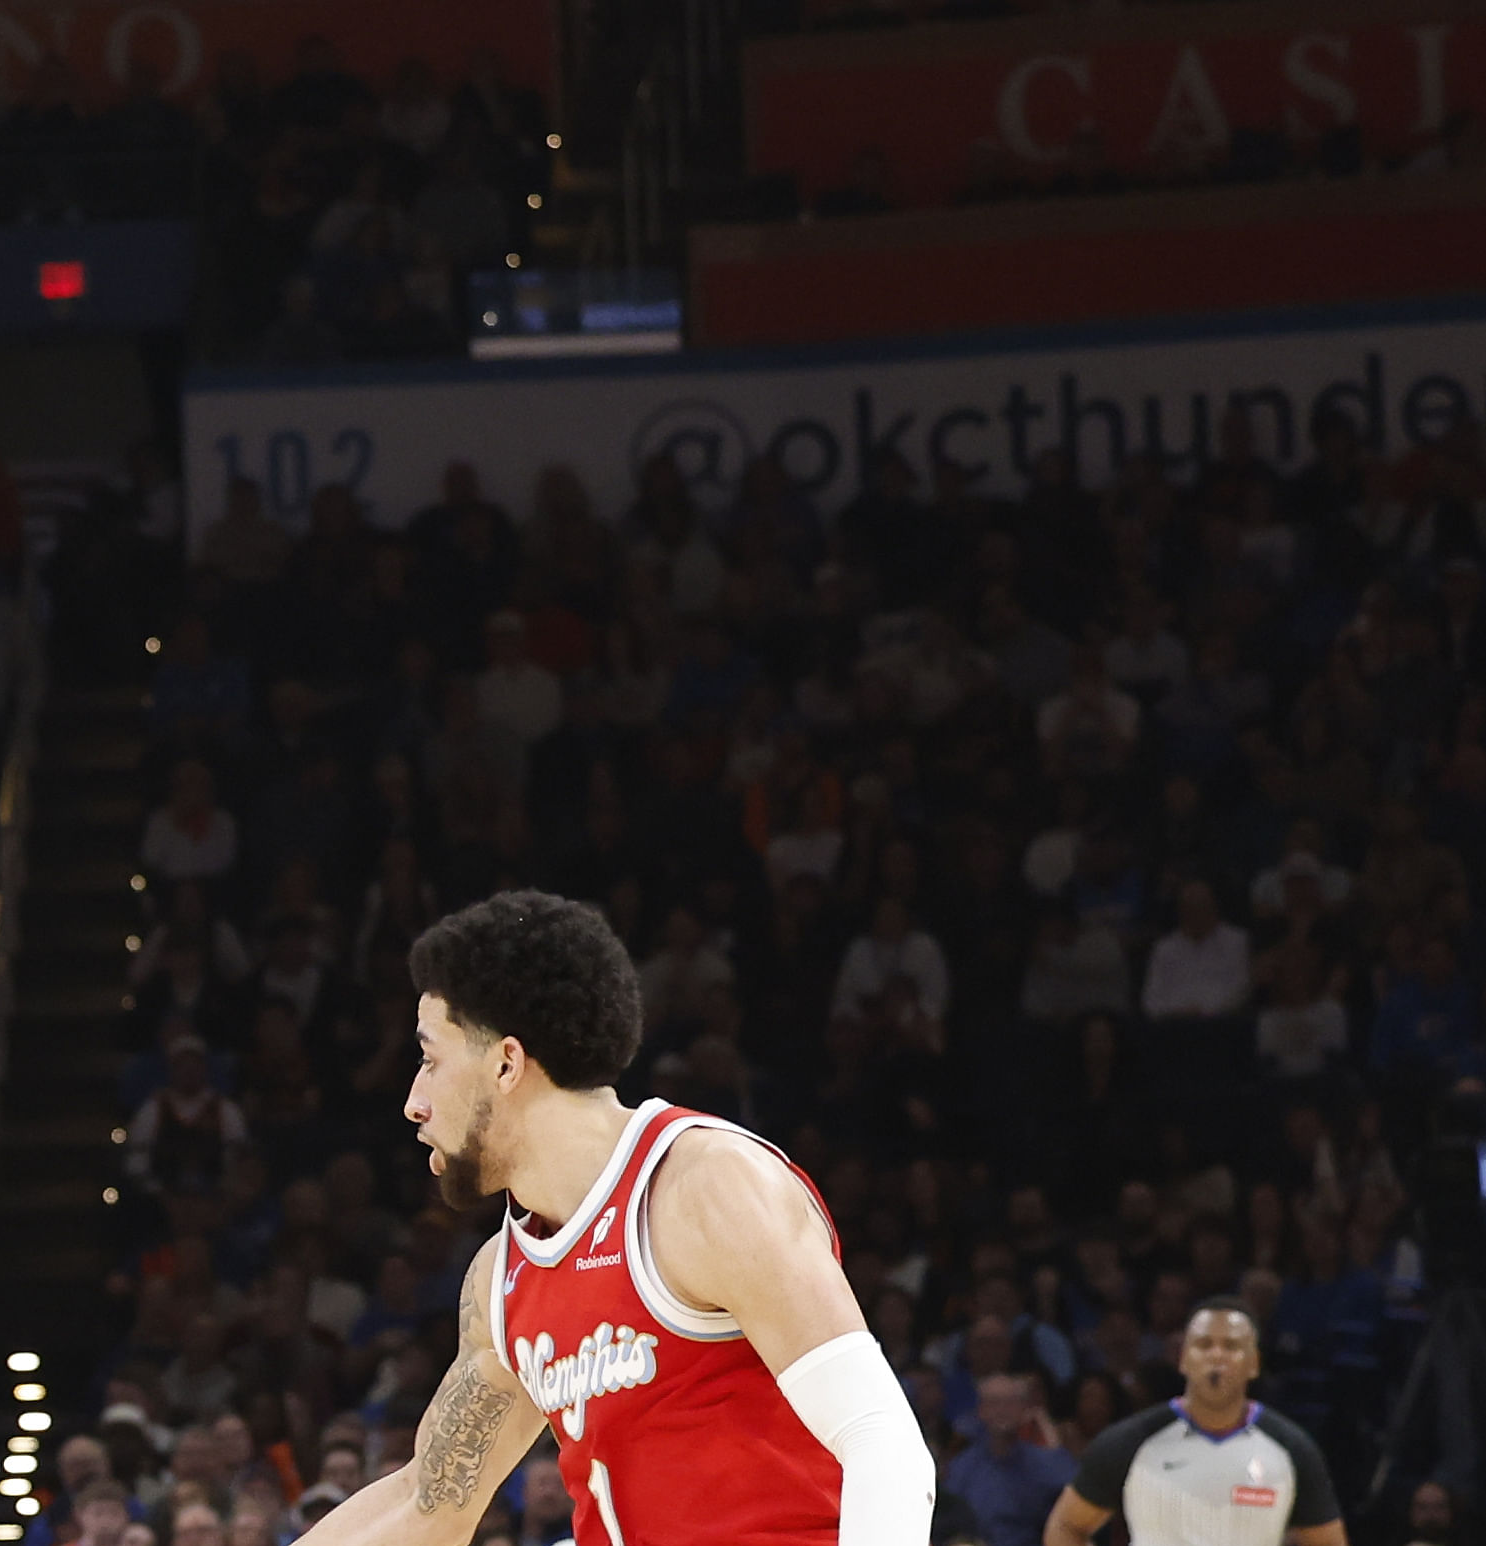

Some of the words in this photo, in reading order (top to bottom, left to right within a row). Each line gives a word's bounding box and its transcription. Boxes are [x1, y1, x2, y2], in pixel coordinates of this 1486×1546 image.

[629, 351, 1486, 494] @okcthunde
[576, 1251, 621, 1271] Robinhood
[515, 1321, 658, 1441] Memphis
